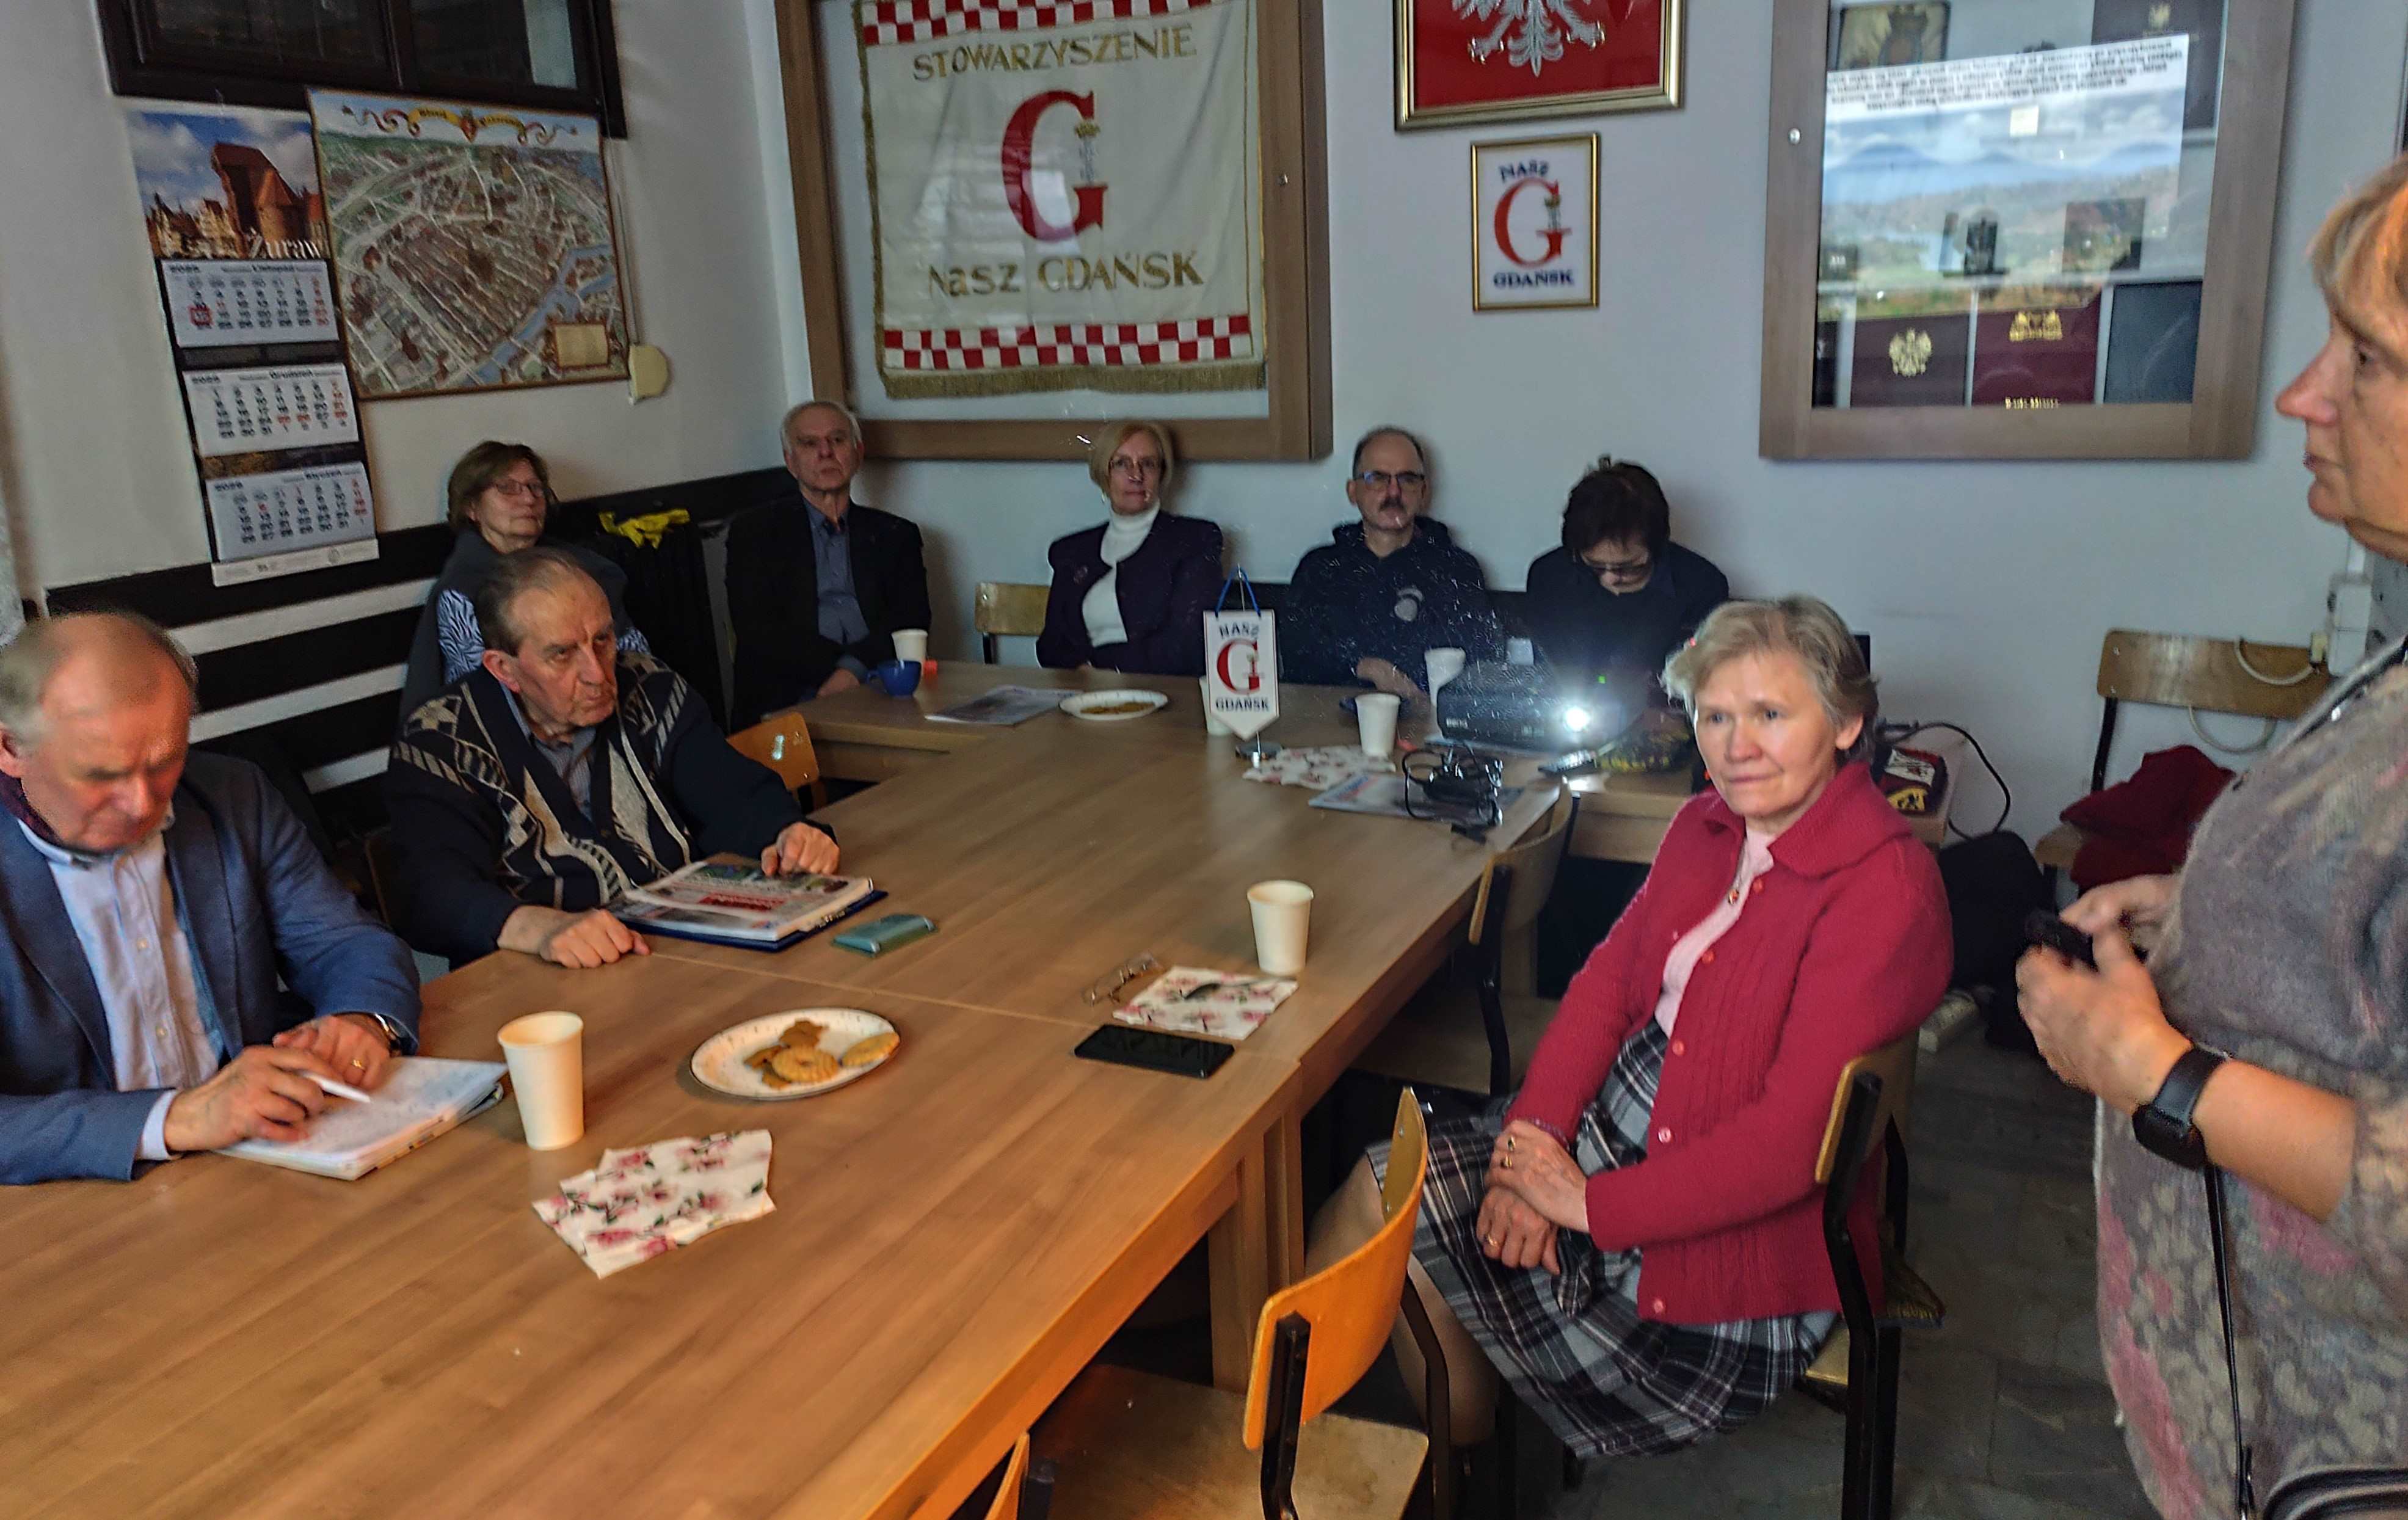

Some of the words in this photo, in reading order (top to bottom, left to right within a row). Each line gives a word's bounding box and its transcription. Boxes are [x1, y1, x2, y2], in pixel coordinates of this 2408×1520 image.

[913, 24, 1198, 81] STOWARZYSZENIE
[1001, 90, 1108, 242] G
[1494, 176, 1572, 269] G
[1217, 638, 1262, 695] G
